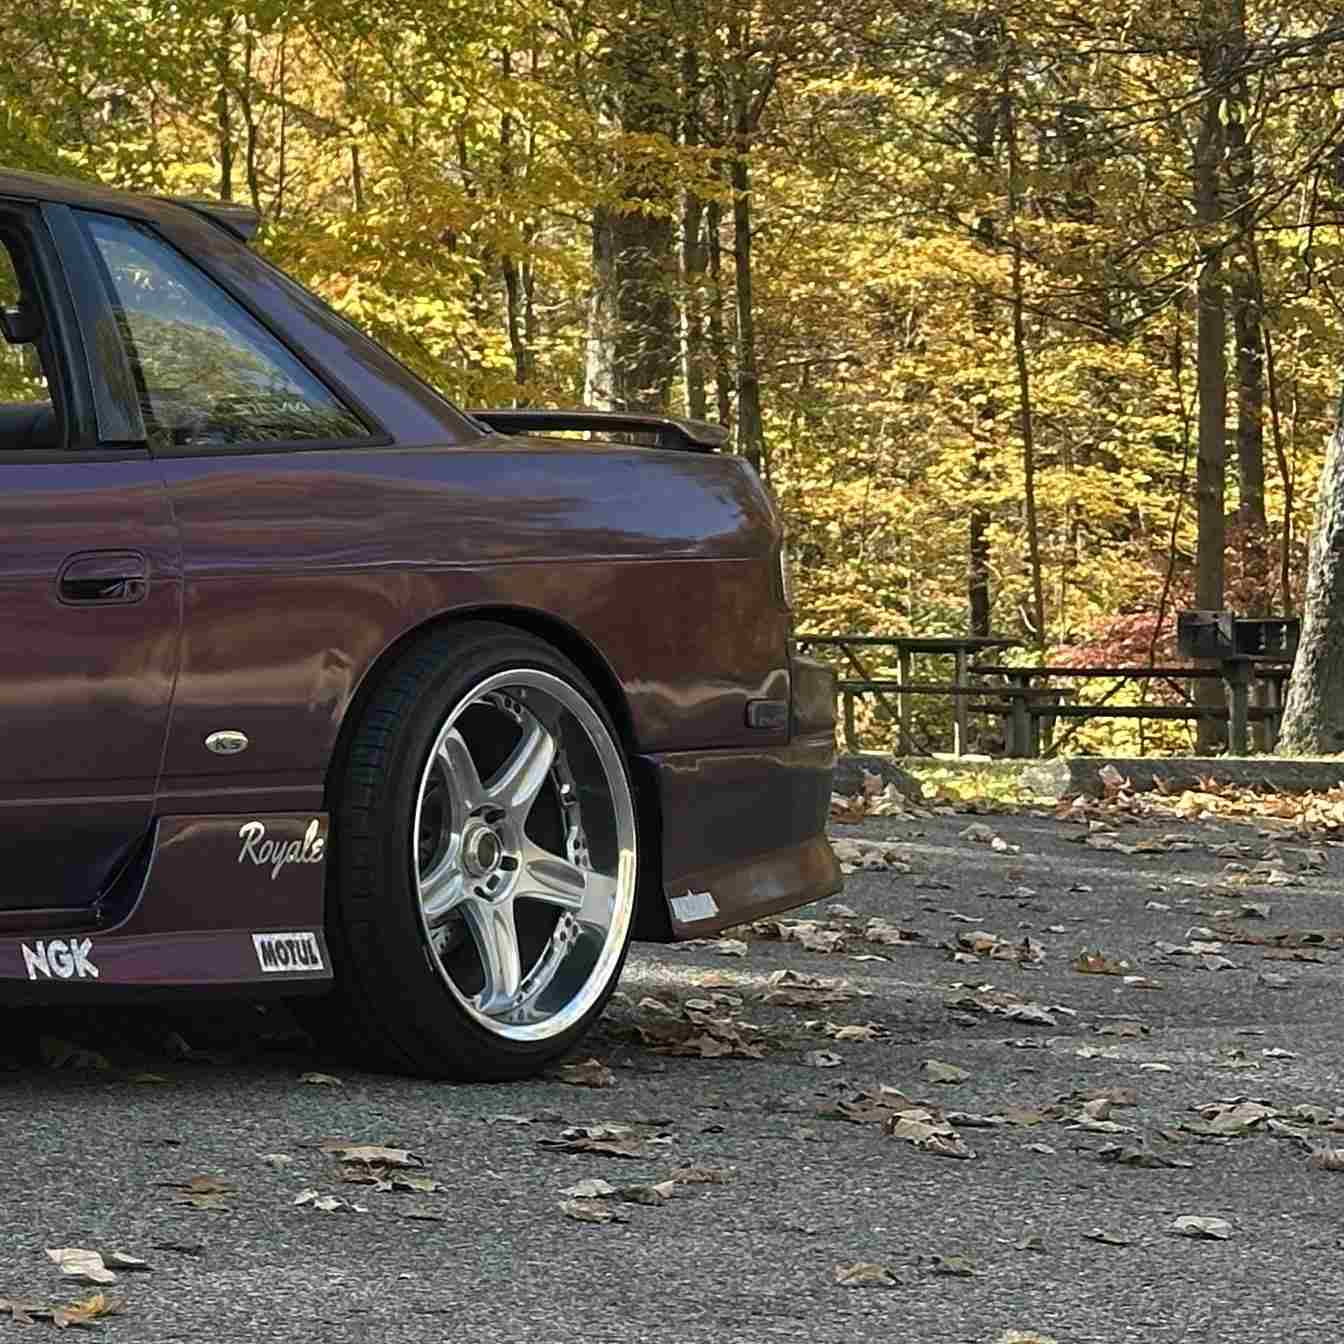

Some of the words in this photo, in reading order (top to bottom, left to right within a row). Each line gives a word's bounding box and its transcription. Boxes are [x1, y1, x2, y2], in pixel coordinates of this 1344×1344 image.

[238, 819, 324, 880] Royale
[21, 937, 99, 980] NGK
[260, 939, 319, 967] MOTUL
